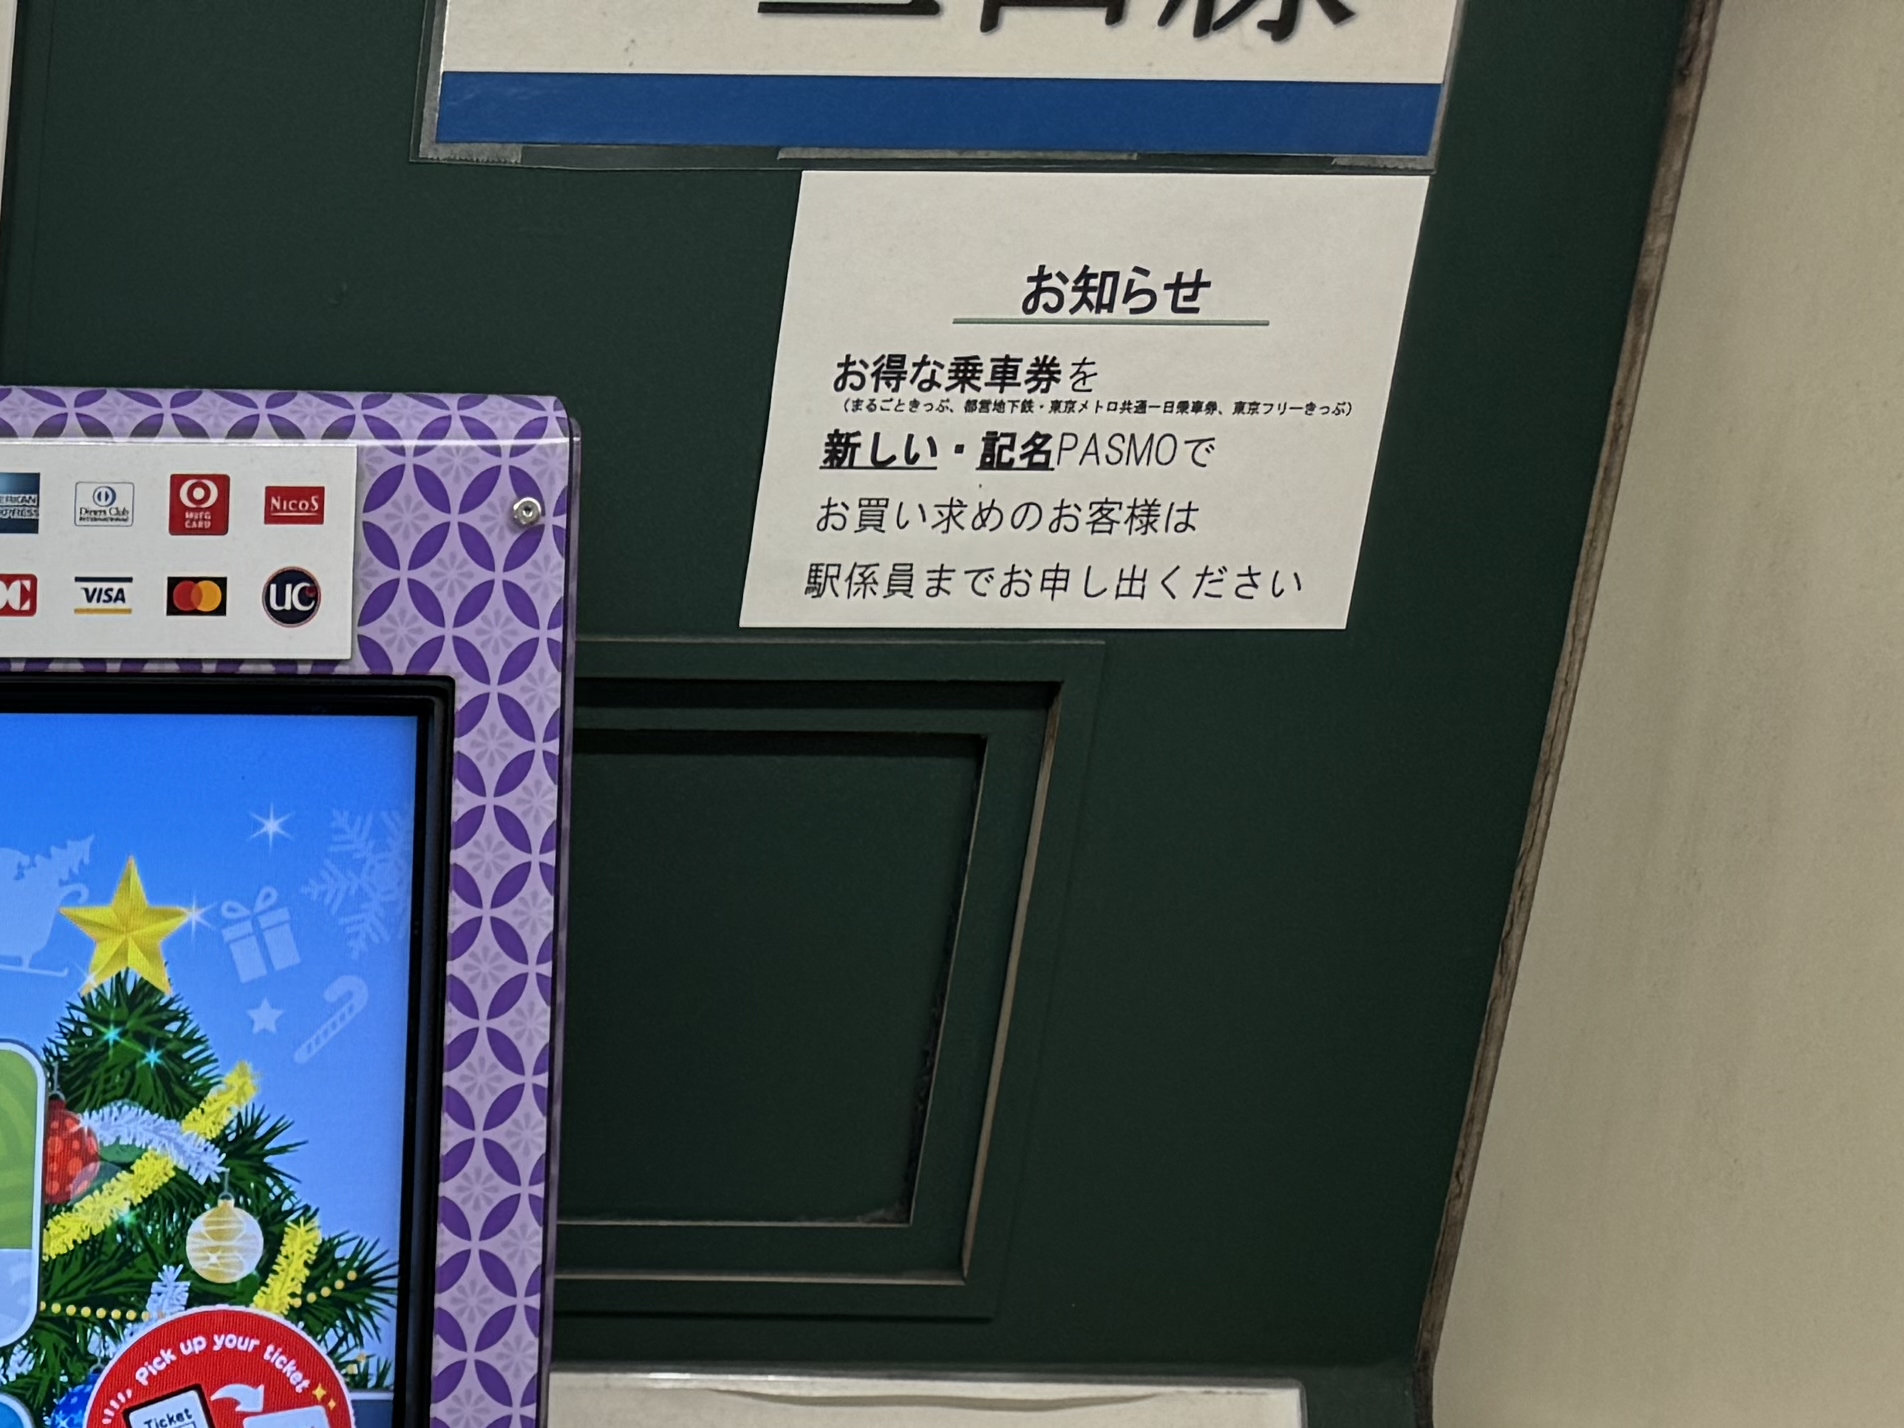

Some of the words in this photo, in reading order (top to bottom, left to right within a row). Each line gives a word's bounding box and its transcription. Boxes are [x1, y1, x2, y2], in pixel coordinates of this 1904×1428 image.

[1019, 264, 1212, 316] お知らせ
[833, 354, 1098, 394] お得な乗車券を
[109, 507, 130, 516] Club
[185, 520, 211, 529] CARD
[815, 496, 1197, 537] お買い求めのお客様は
[81, 587, 126, 604] VISA
[806, 560, 1303, 602] 駅係員までお申し出ください
[134, 1346, 177, 1386] Pick
[180, 1335, 207, 1357] up
[212, 1333, 260, 1353] your
[263, 1344, 310, 1393] ticket
